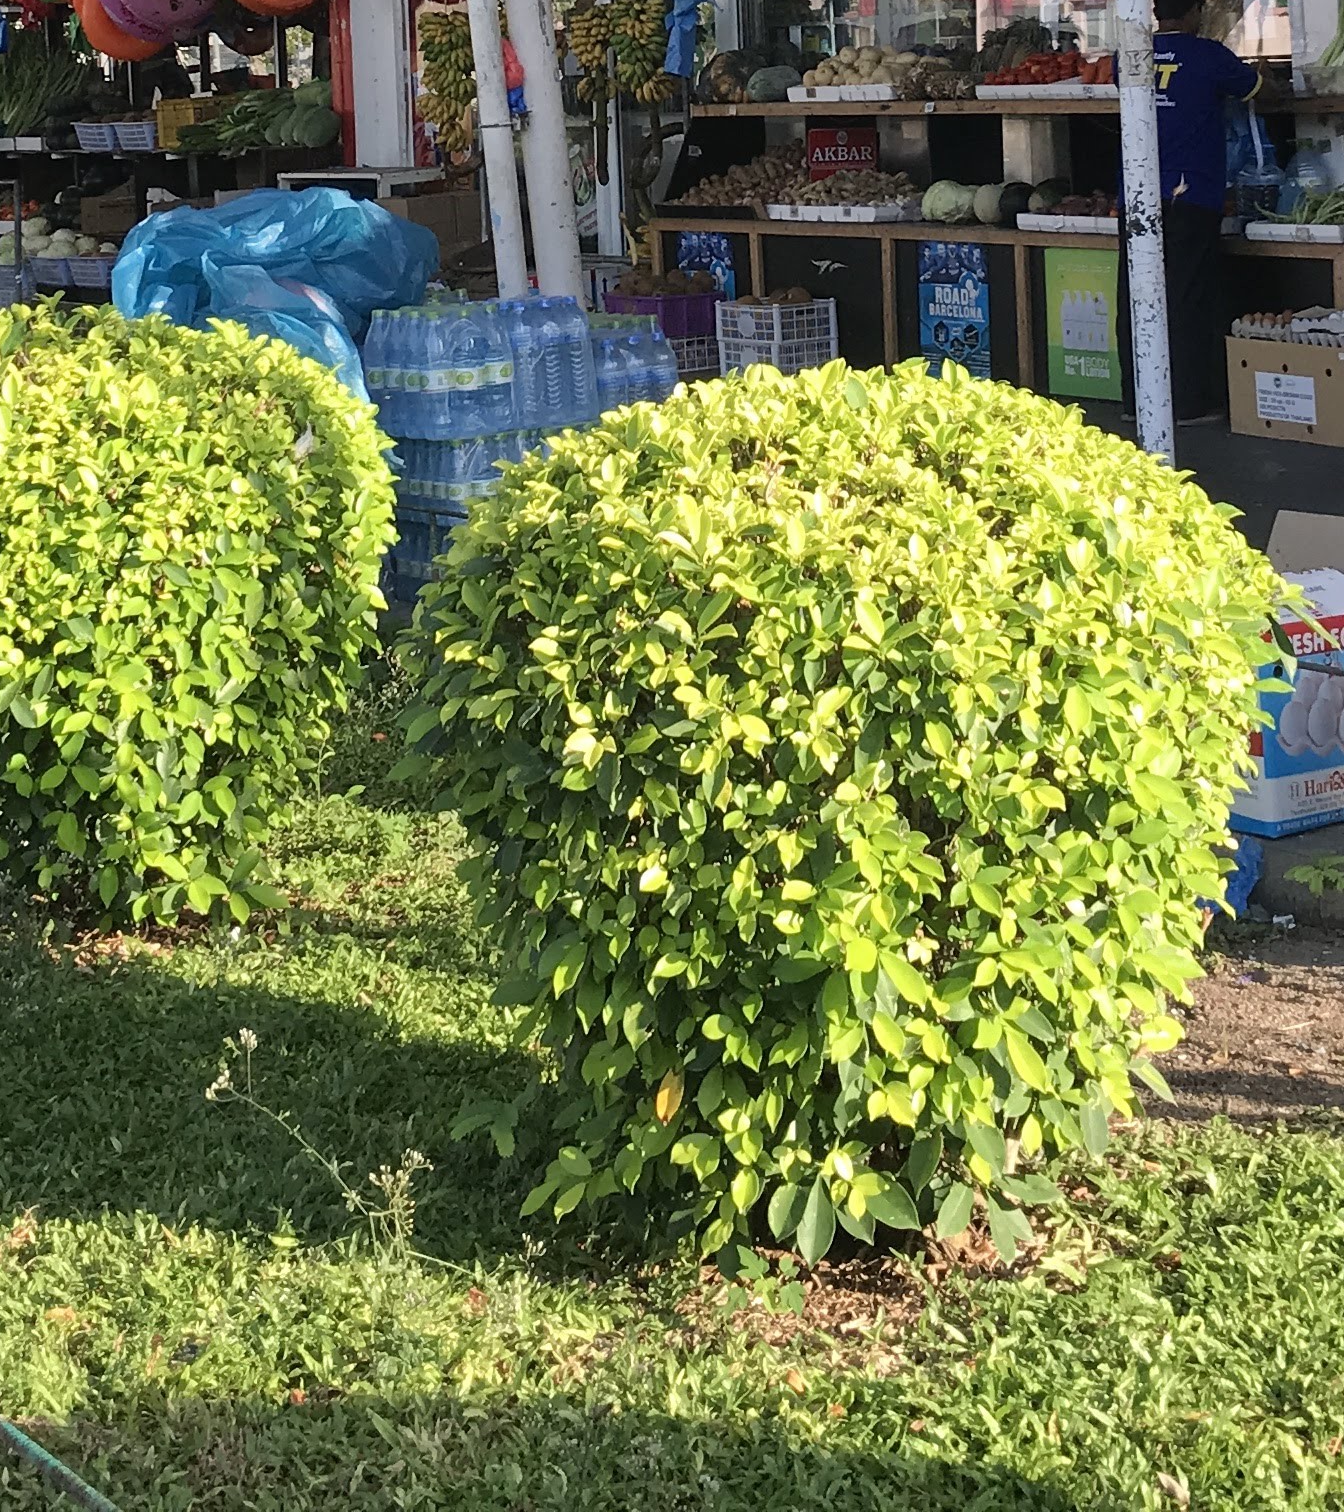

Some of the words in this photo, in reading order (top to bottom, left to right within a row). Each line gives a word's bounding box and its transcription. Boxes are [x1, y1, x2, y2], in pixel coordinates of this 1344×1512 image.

[1154, 63, 1180, 90] T
[811, 145, 874, 163] AKBAR
[934, 286, 970, 306] ROAD
[928, 302, 984, 321] BARCELONA
